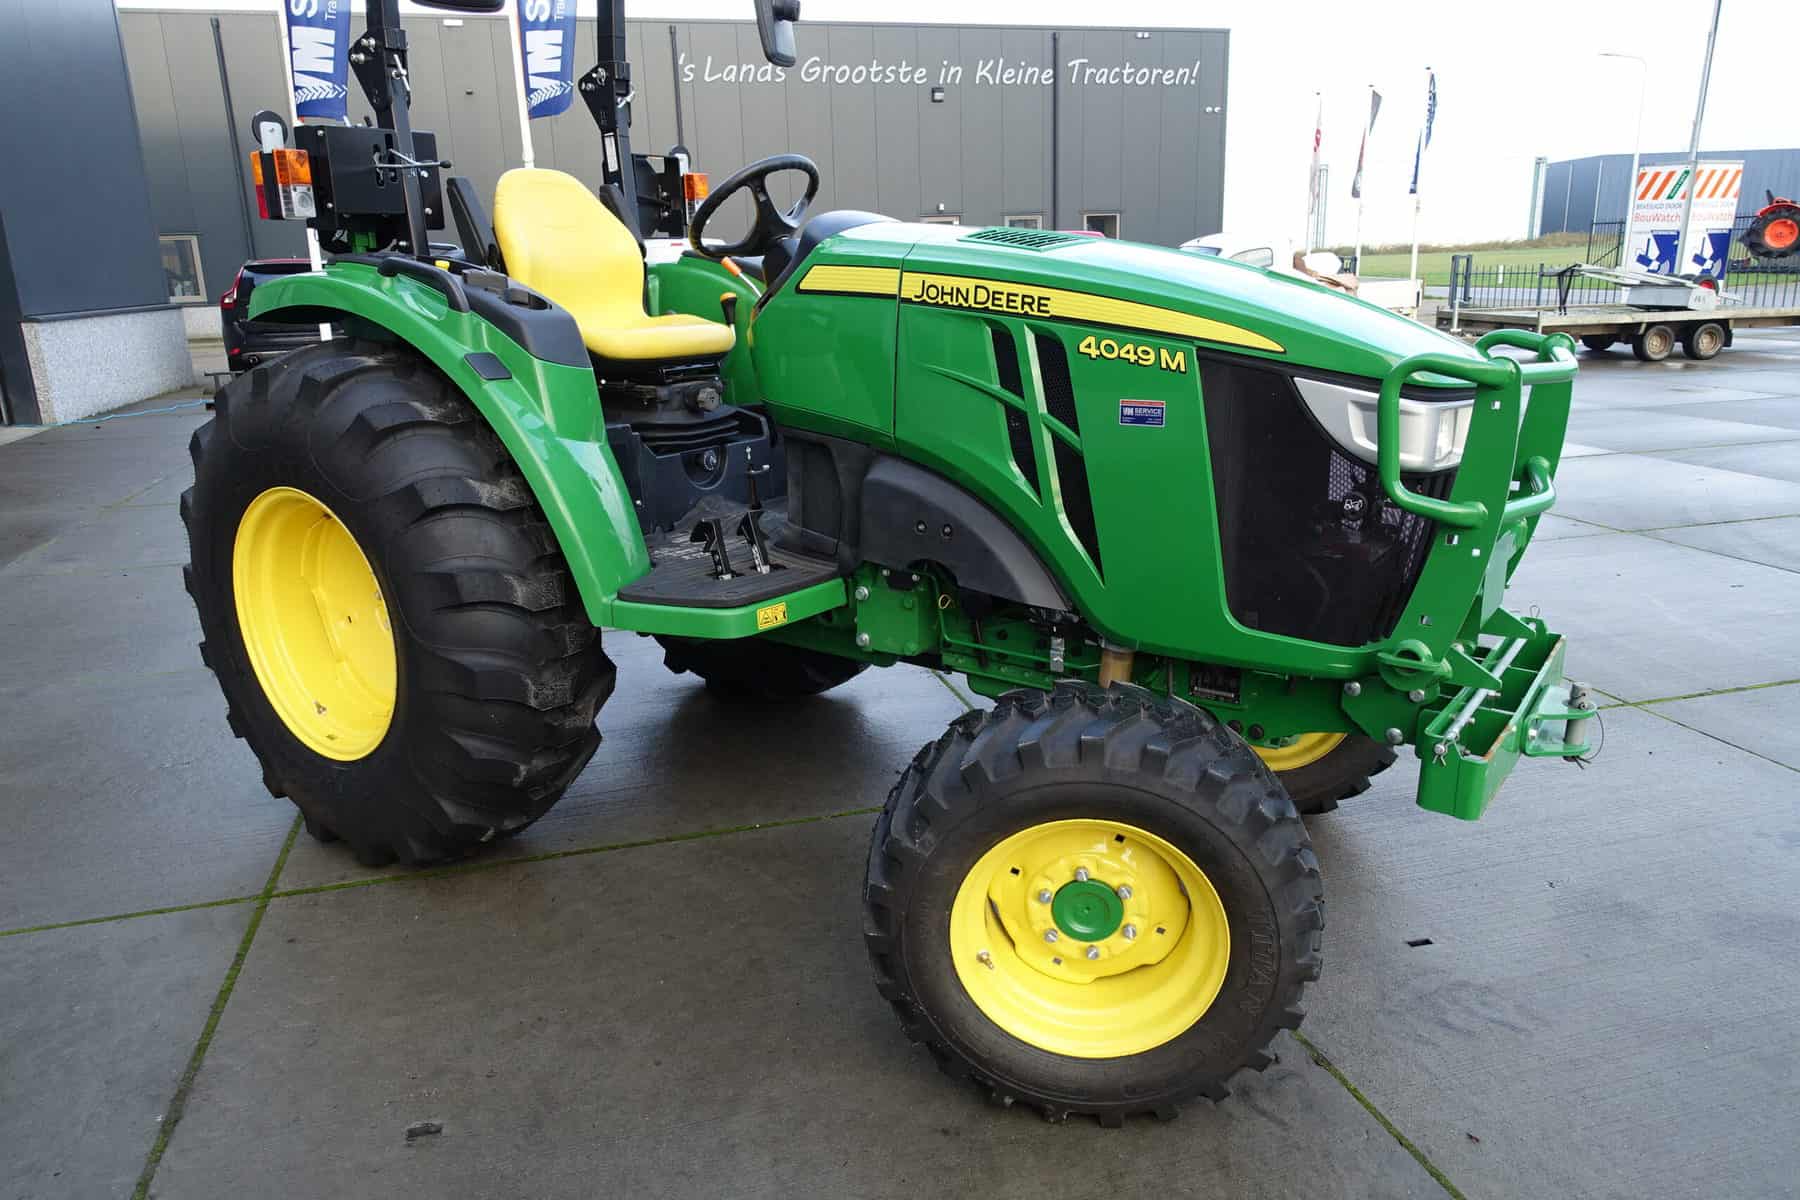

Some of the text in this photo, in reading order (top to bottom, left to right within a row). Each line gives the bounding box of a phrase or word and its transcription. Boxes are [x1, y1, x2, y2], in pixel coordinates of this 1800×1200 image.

[704, 55, 786, 83] Lands
[800, 56, 927, 84] Grootste
[939, 60, 962, 84] in
[975, 59, 1054, 85] Kleine
[1067, 59, 1200, 86] Tractoren!
[913, 279, 1051, 314] JOHN DEERE
[1078, 334, 1188, 374] 4049 M
